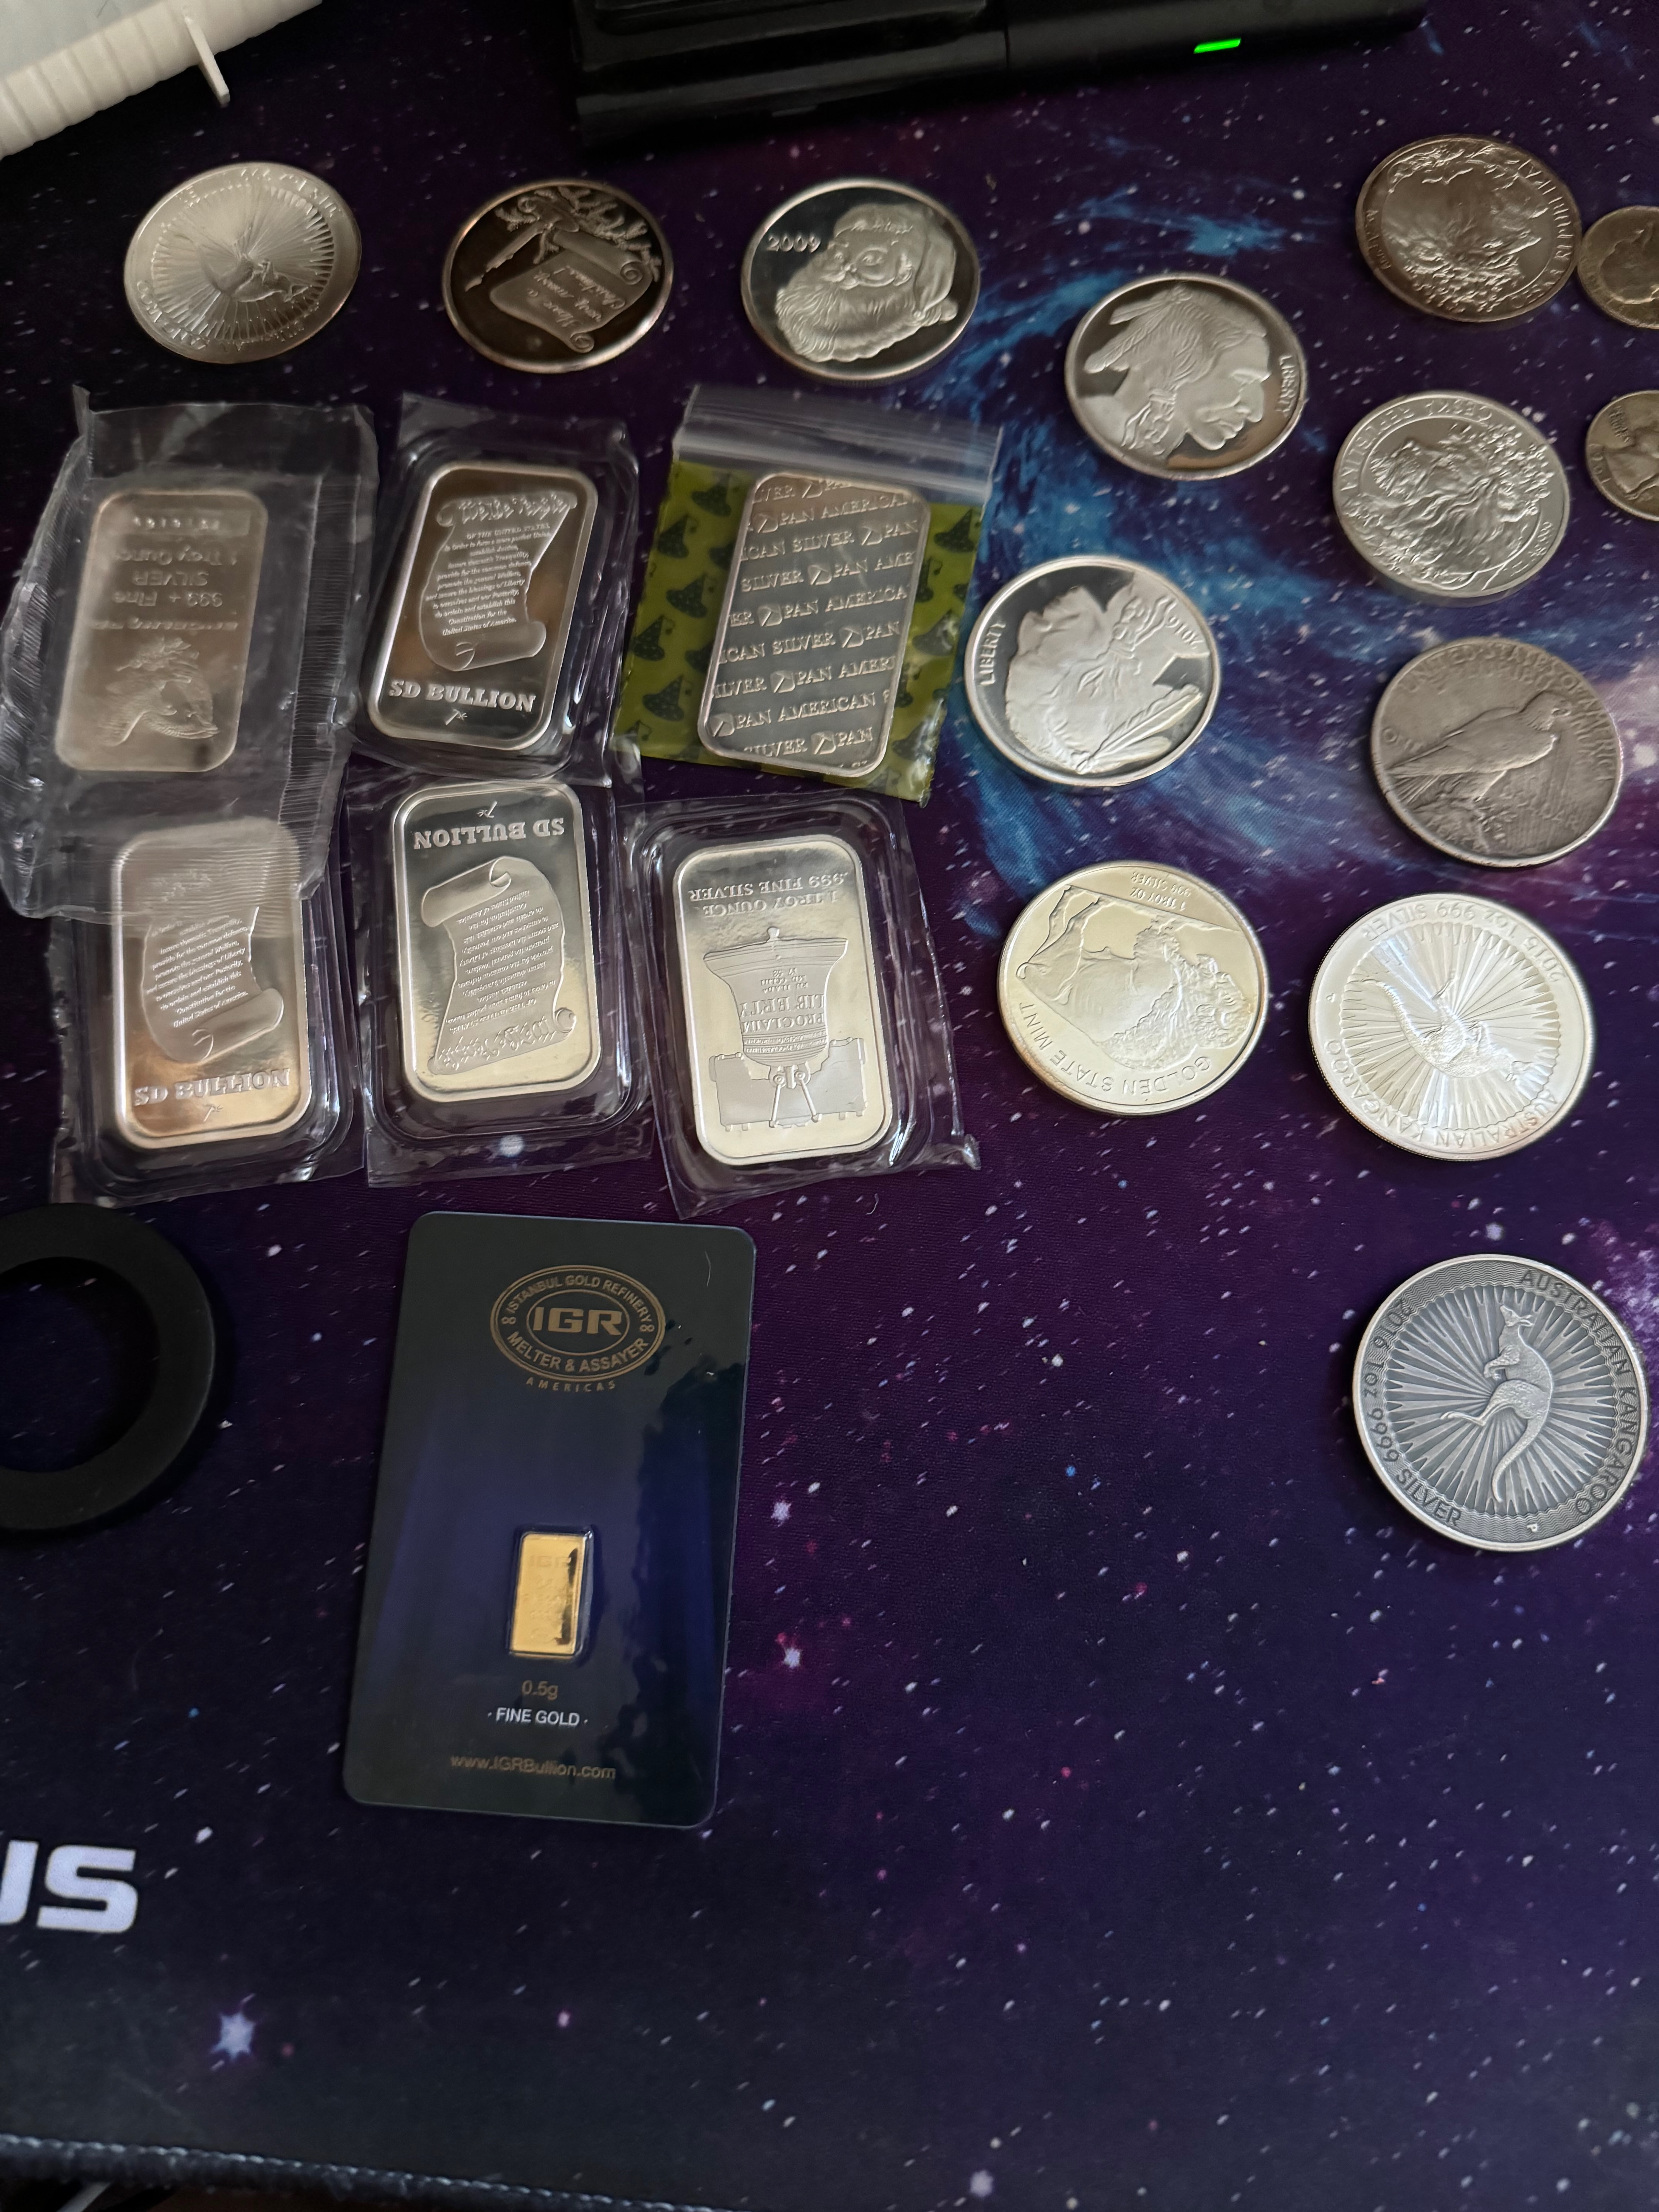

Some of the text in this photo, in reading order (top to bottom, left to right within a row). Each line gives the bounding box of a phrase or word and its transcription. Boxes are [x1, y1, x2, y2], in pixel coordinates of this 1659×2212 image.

[767, 235, 821, 253] 2009
[779, 507, 815, 526] PAN
[792, 530, 855, 554] SILVER
[883, 519, 919, 538] PAN
[132, 570, 208, 586] SILVER
[740, 570, 804, 593] SILVER
[832, 558, 869, 579] PAN
[784, 599, 819, 620] PAN
[771, 632, 836, 656] SILVER
[864, 621, 902, 641] PAN
[980, 623, 1006, 687] LIBERTY
[795, 666, 832, 685] PAN
[389, 679, 536, 712] SD BULLION
[736, 692, 876, 730] PAN AMERICAN
[836, 726, 873, 748] PAN
[413, 817, 565, 850] SD BULLION
[688, 883, 753, 901] SILVER
[758, 878, 802, 892] FINE
[1129, 871, 1170, 892] SILVER
[702, 890, 838, 917] 1 TROY OUNCE
[1363, 903, 1427, 941] SILVER
[1525, 936, 1566, 982] 2015
[742, 1012, 826, 1034] PROCLAIM
[1019, 1002, 1211, 1096] GOLDEN STATE MINT
[134, 1067, 290, 1106] SD BULLION
[1323, 1039, 1558, 1148] AUSTRALIAN KANGAROO
[507, 1274, 653, 1322] ISTANBUL GOLD REFINERY
[532, 1307, 622, 1336] IGR
[507, 1331, 649, 1373] MELTER & ASSAYER
[526, 1376, 616, 1393] AMERICAS
[1520, 1269, 1638, 1516] AUSTRALIAN KANGAROO
[1369, 1408, 1400, 1463] 9999
[1396, 1468, 1461, 1526] SILVER
[521, 1680, 558, 1700] 0.5g
[495, 1707, 580, 1727] FINE GOLD
[450, 1755, 617, 1779] www.IGRBullion.com
